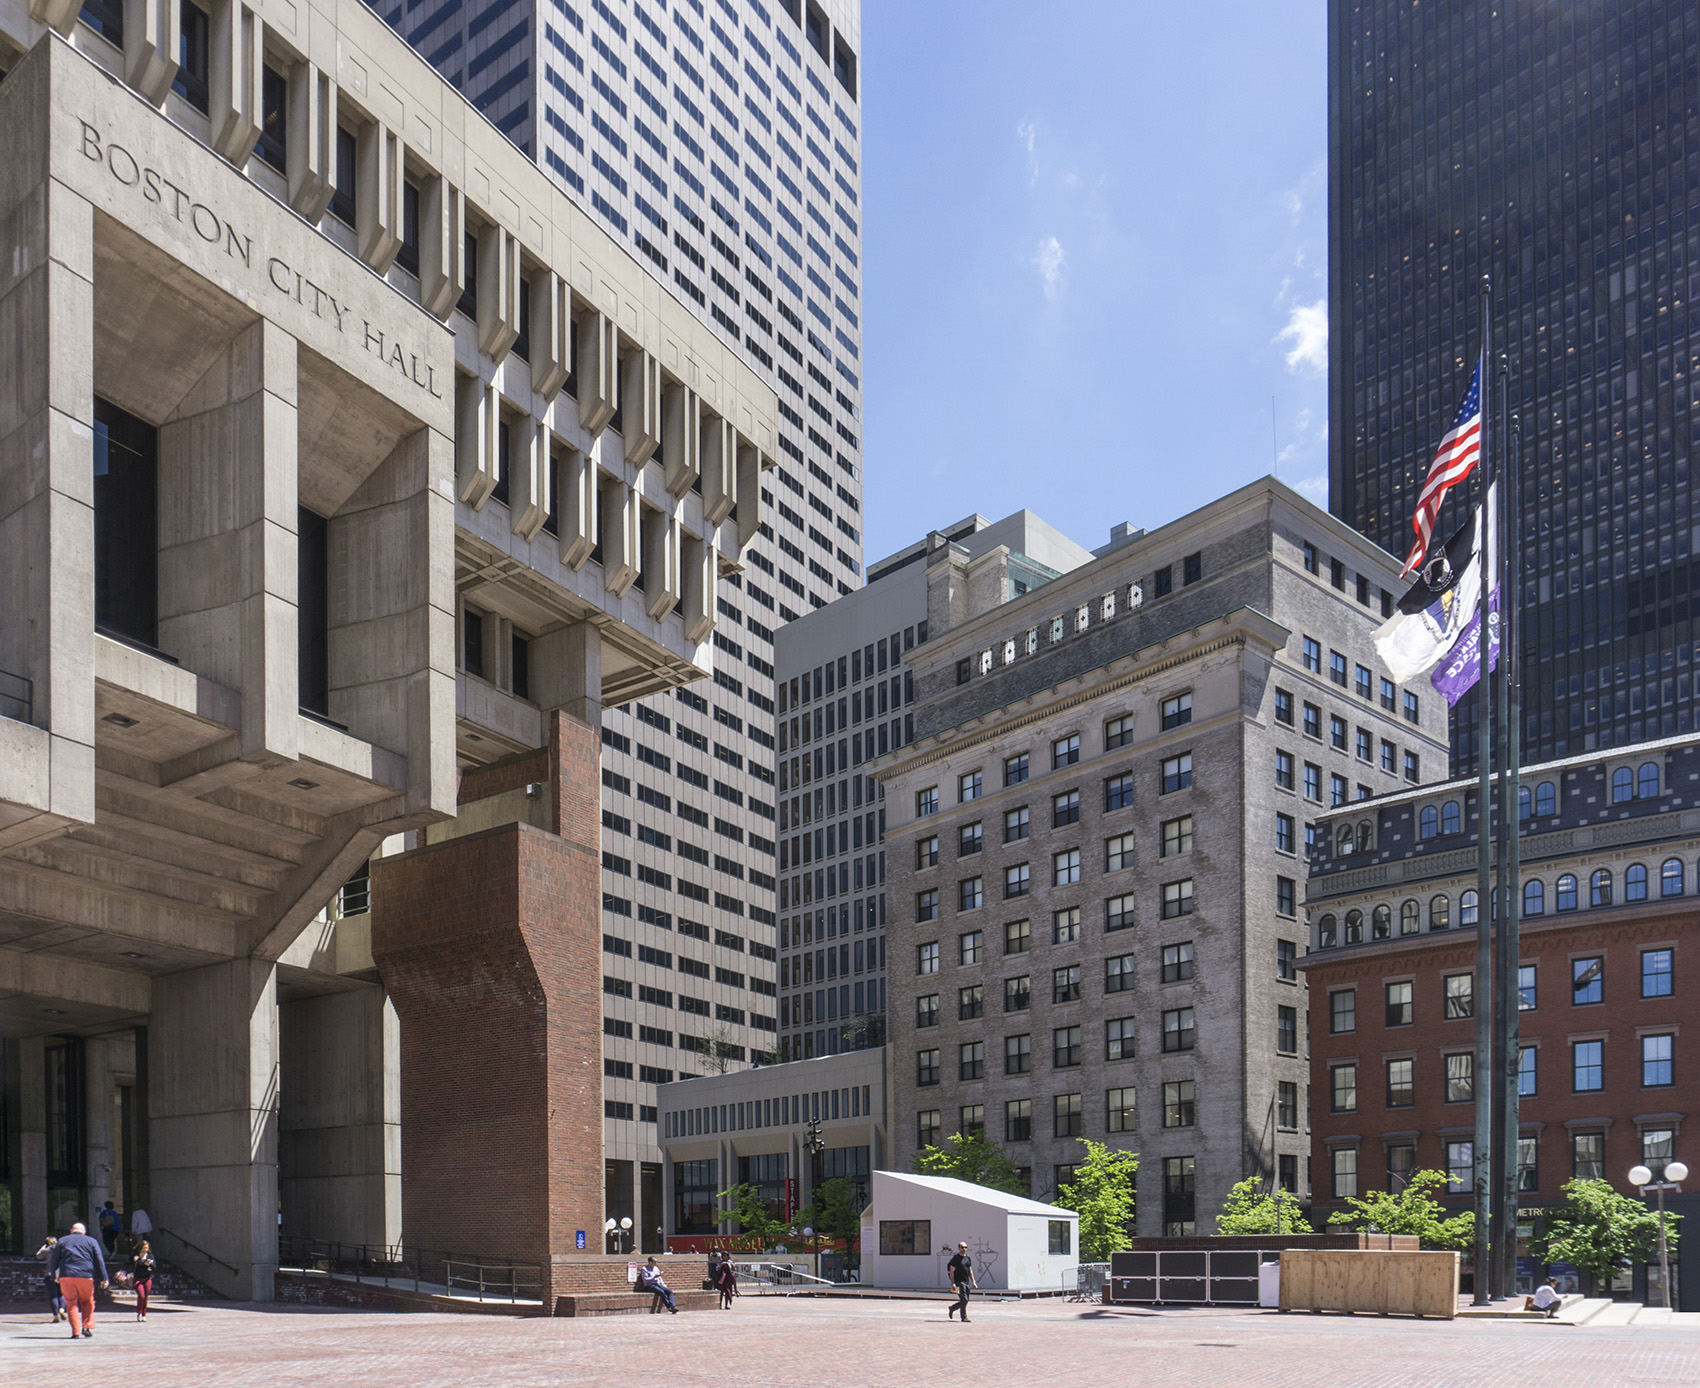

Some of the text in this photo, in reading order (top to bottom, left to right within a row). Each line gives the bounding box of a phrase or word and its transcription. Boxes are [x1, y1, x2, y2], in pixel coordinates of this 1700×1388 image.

[77, 119, 443, 399] BOSTON CITY HALL
[703, 1237, 775, 1250] WAX MUSEU
